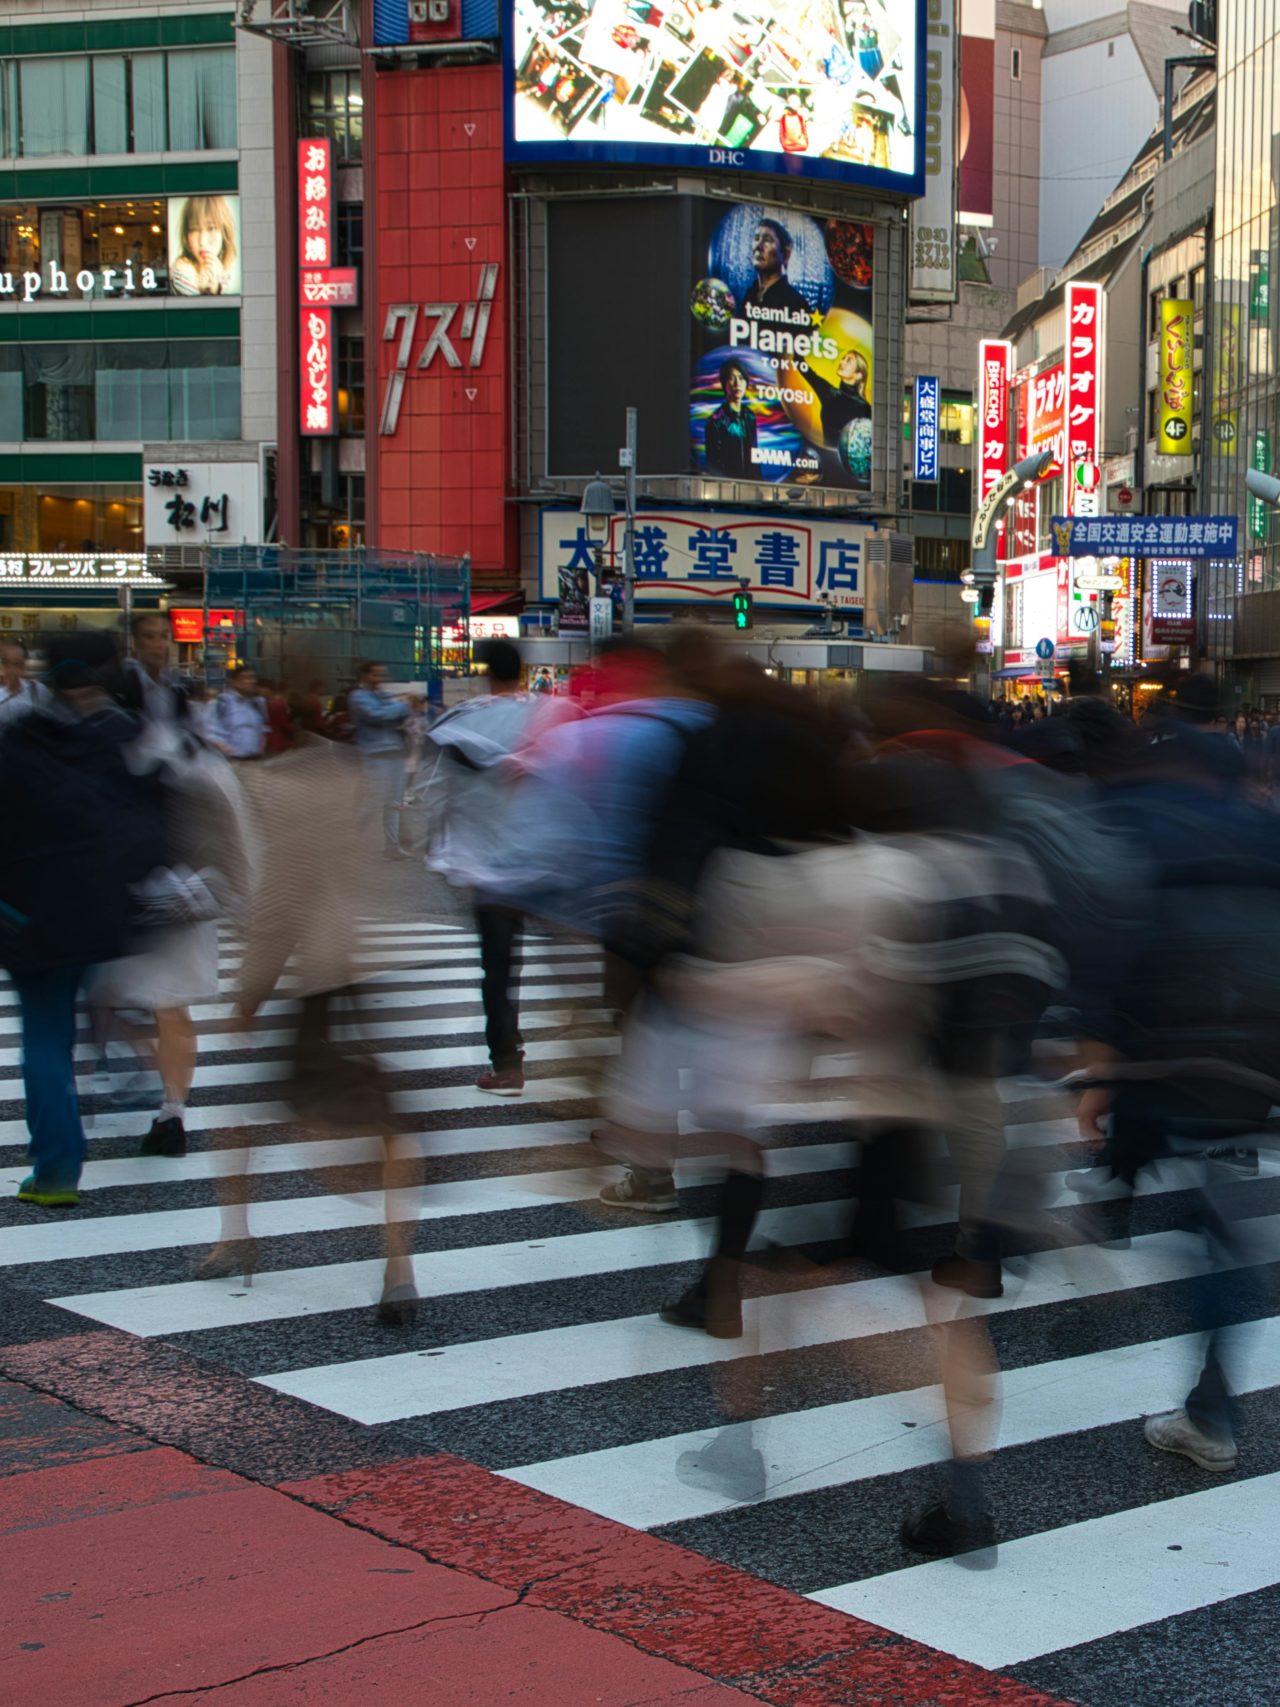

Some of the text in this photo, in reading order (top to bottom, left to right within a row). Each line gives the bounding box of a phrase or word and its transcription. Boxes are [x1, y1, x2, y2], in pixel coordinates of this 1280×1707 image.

[708, 149, 744, 166] DHC
[304, 145, 327, 262] お好み焼
[745, 301, 811, 326] teamLab
[382, 303, 492, 370] クスリ
[729, 318, 839, 360] Planets
[306, 312, 328, 429] もんじゃ焼
[762, 357, 809, 373] TOKYO
[1069, 302, 1095, 427] カラオケ
[756, 385, 814, 405] TOYOSU
[986, 360, 1000, 428] BIG ECHO
[919, 381, 935, 476] 大盛堂商事ビル
[1165, 420, 1186, 437] 4F
[750, 447, 819, 470] DMM.com
[1073, 522, 1233, 545] 全国交通安全運動実施中
[559, 525, 861, 592] 大盛堂書店
